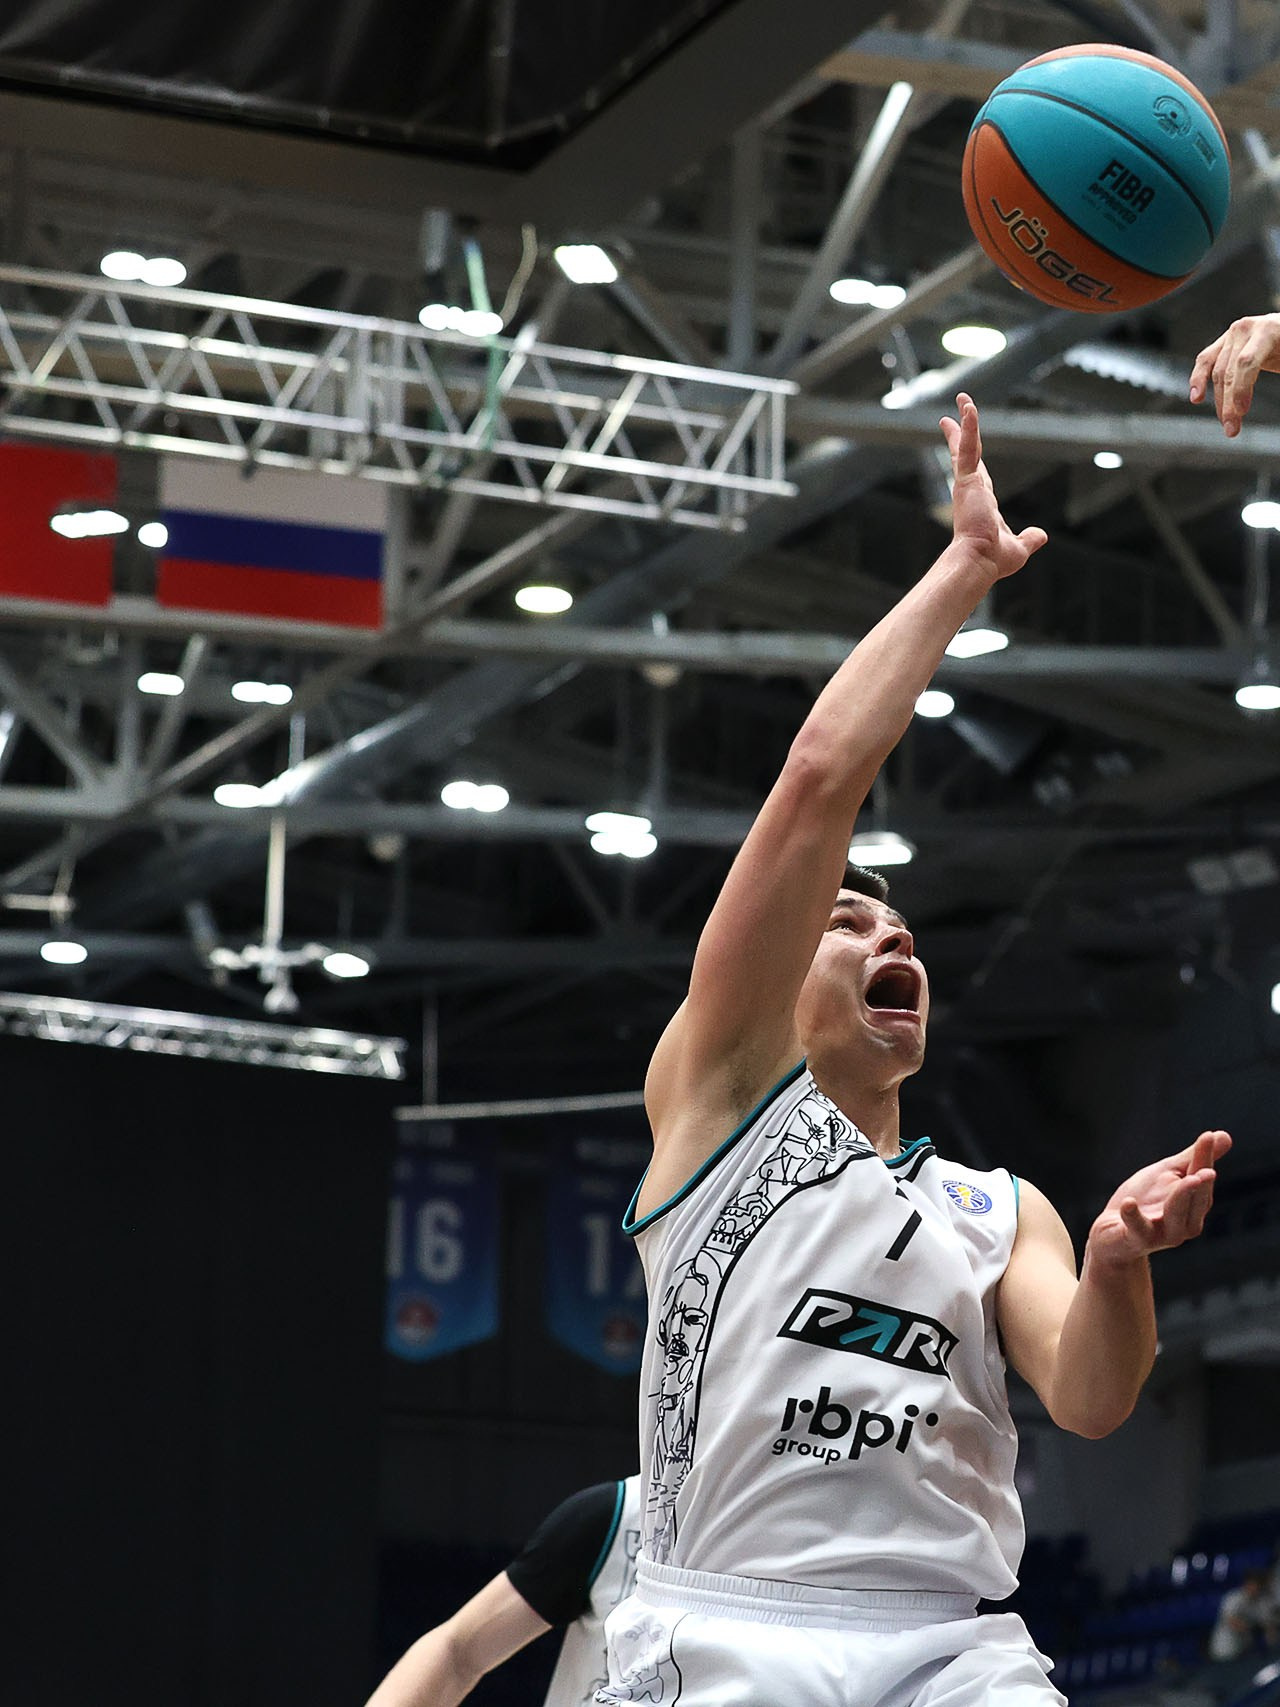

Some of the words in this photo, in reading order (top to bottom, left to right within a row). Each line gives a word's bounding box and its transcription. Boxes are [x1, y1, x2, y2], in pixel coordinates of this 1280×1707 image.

[1099, 159, 1155, 213] FIBA
[991, 197, 1120, 304] JÖGEL
[771, 1437, 841, 1465] group
